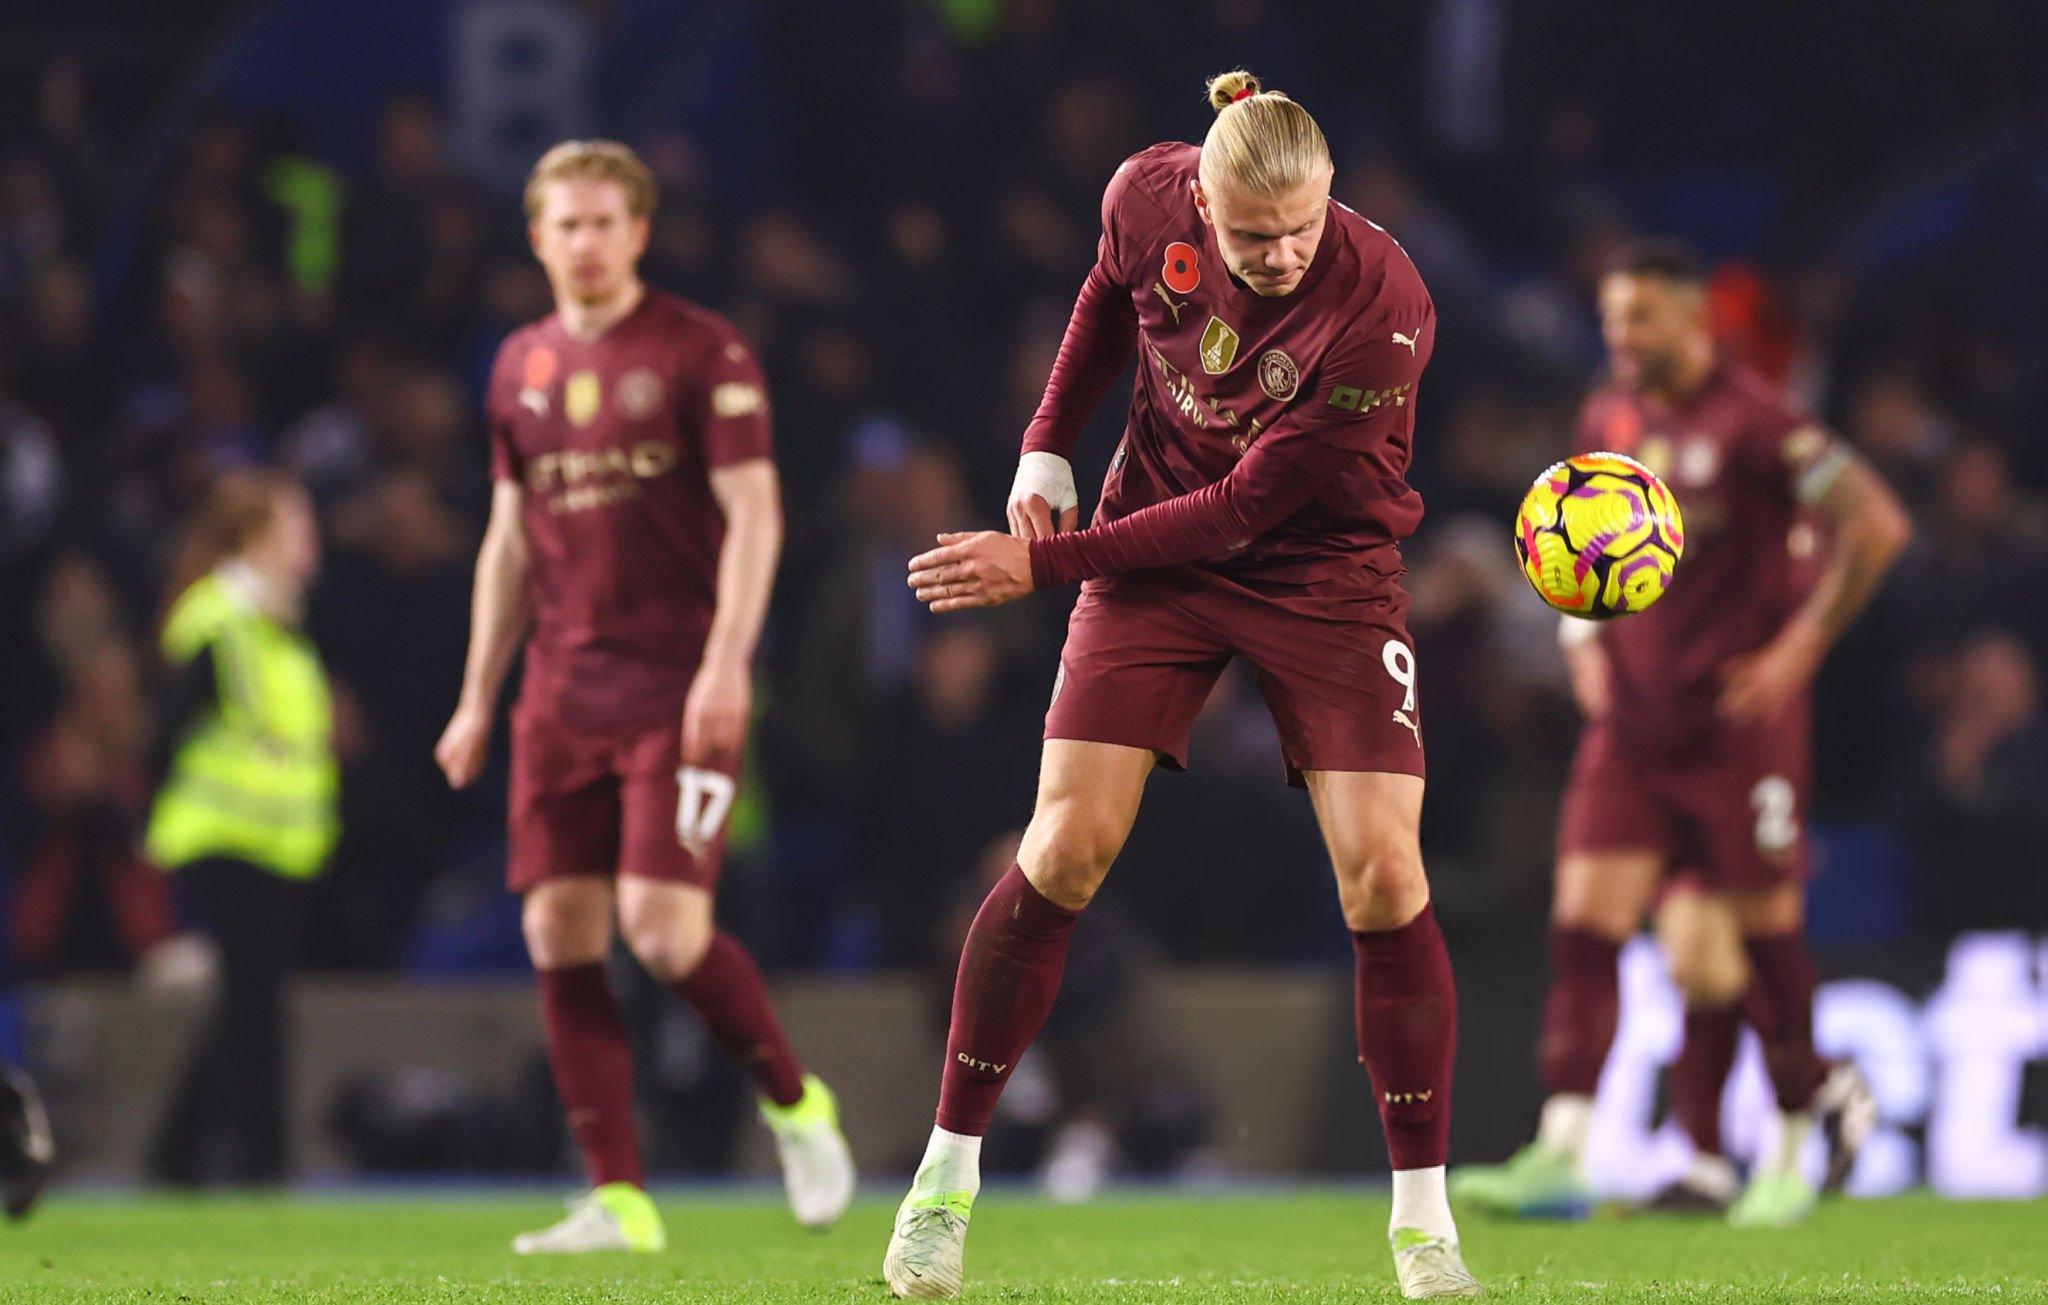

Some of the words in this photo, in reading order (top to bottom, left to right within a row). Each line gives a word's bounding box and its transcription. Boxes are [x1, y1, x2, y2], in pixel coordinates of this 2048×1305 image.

[1382, 639, 1415, 712] 9
[675, 765, 736, 842] 17
[1749, 774, 1799, 848] 2
